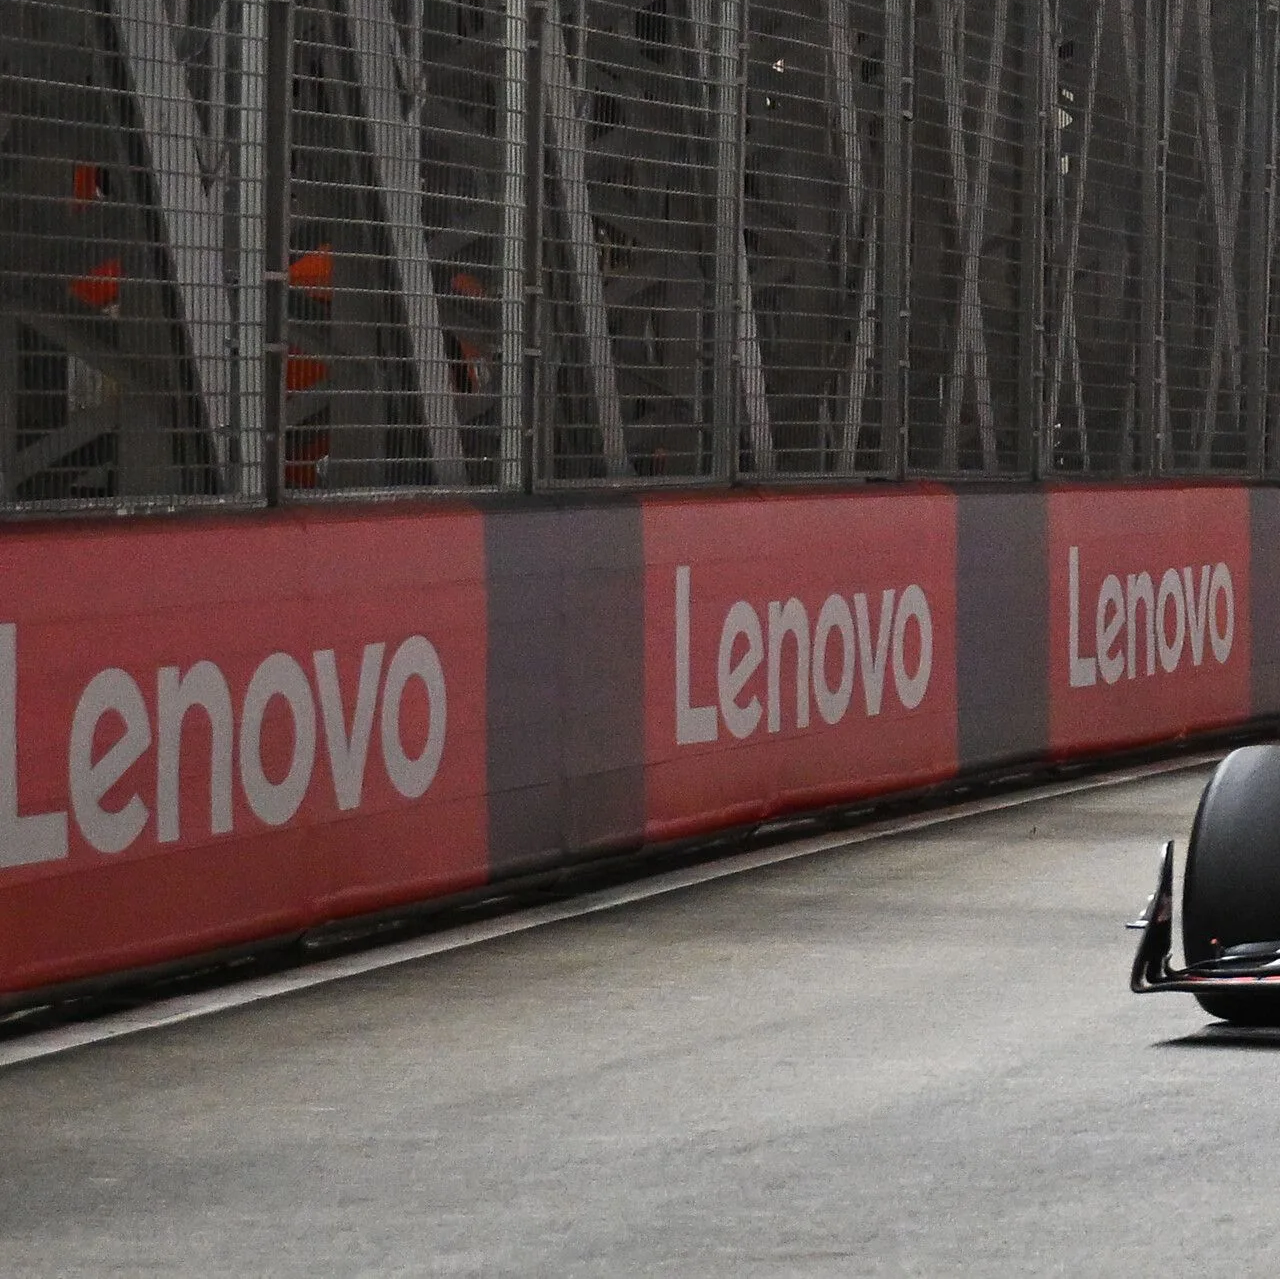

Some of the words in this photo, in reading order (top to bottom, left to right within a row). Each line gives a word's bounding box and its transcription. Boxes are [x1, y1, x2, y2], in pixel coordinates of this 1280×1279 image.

[675, 565, 933, 745] Lenovo
[1068, 546, 1235, 688] Lenovo
[0, 623, 447, 869] Lenovo
